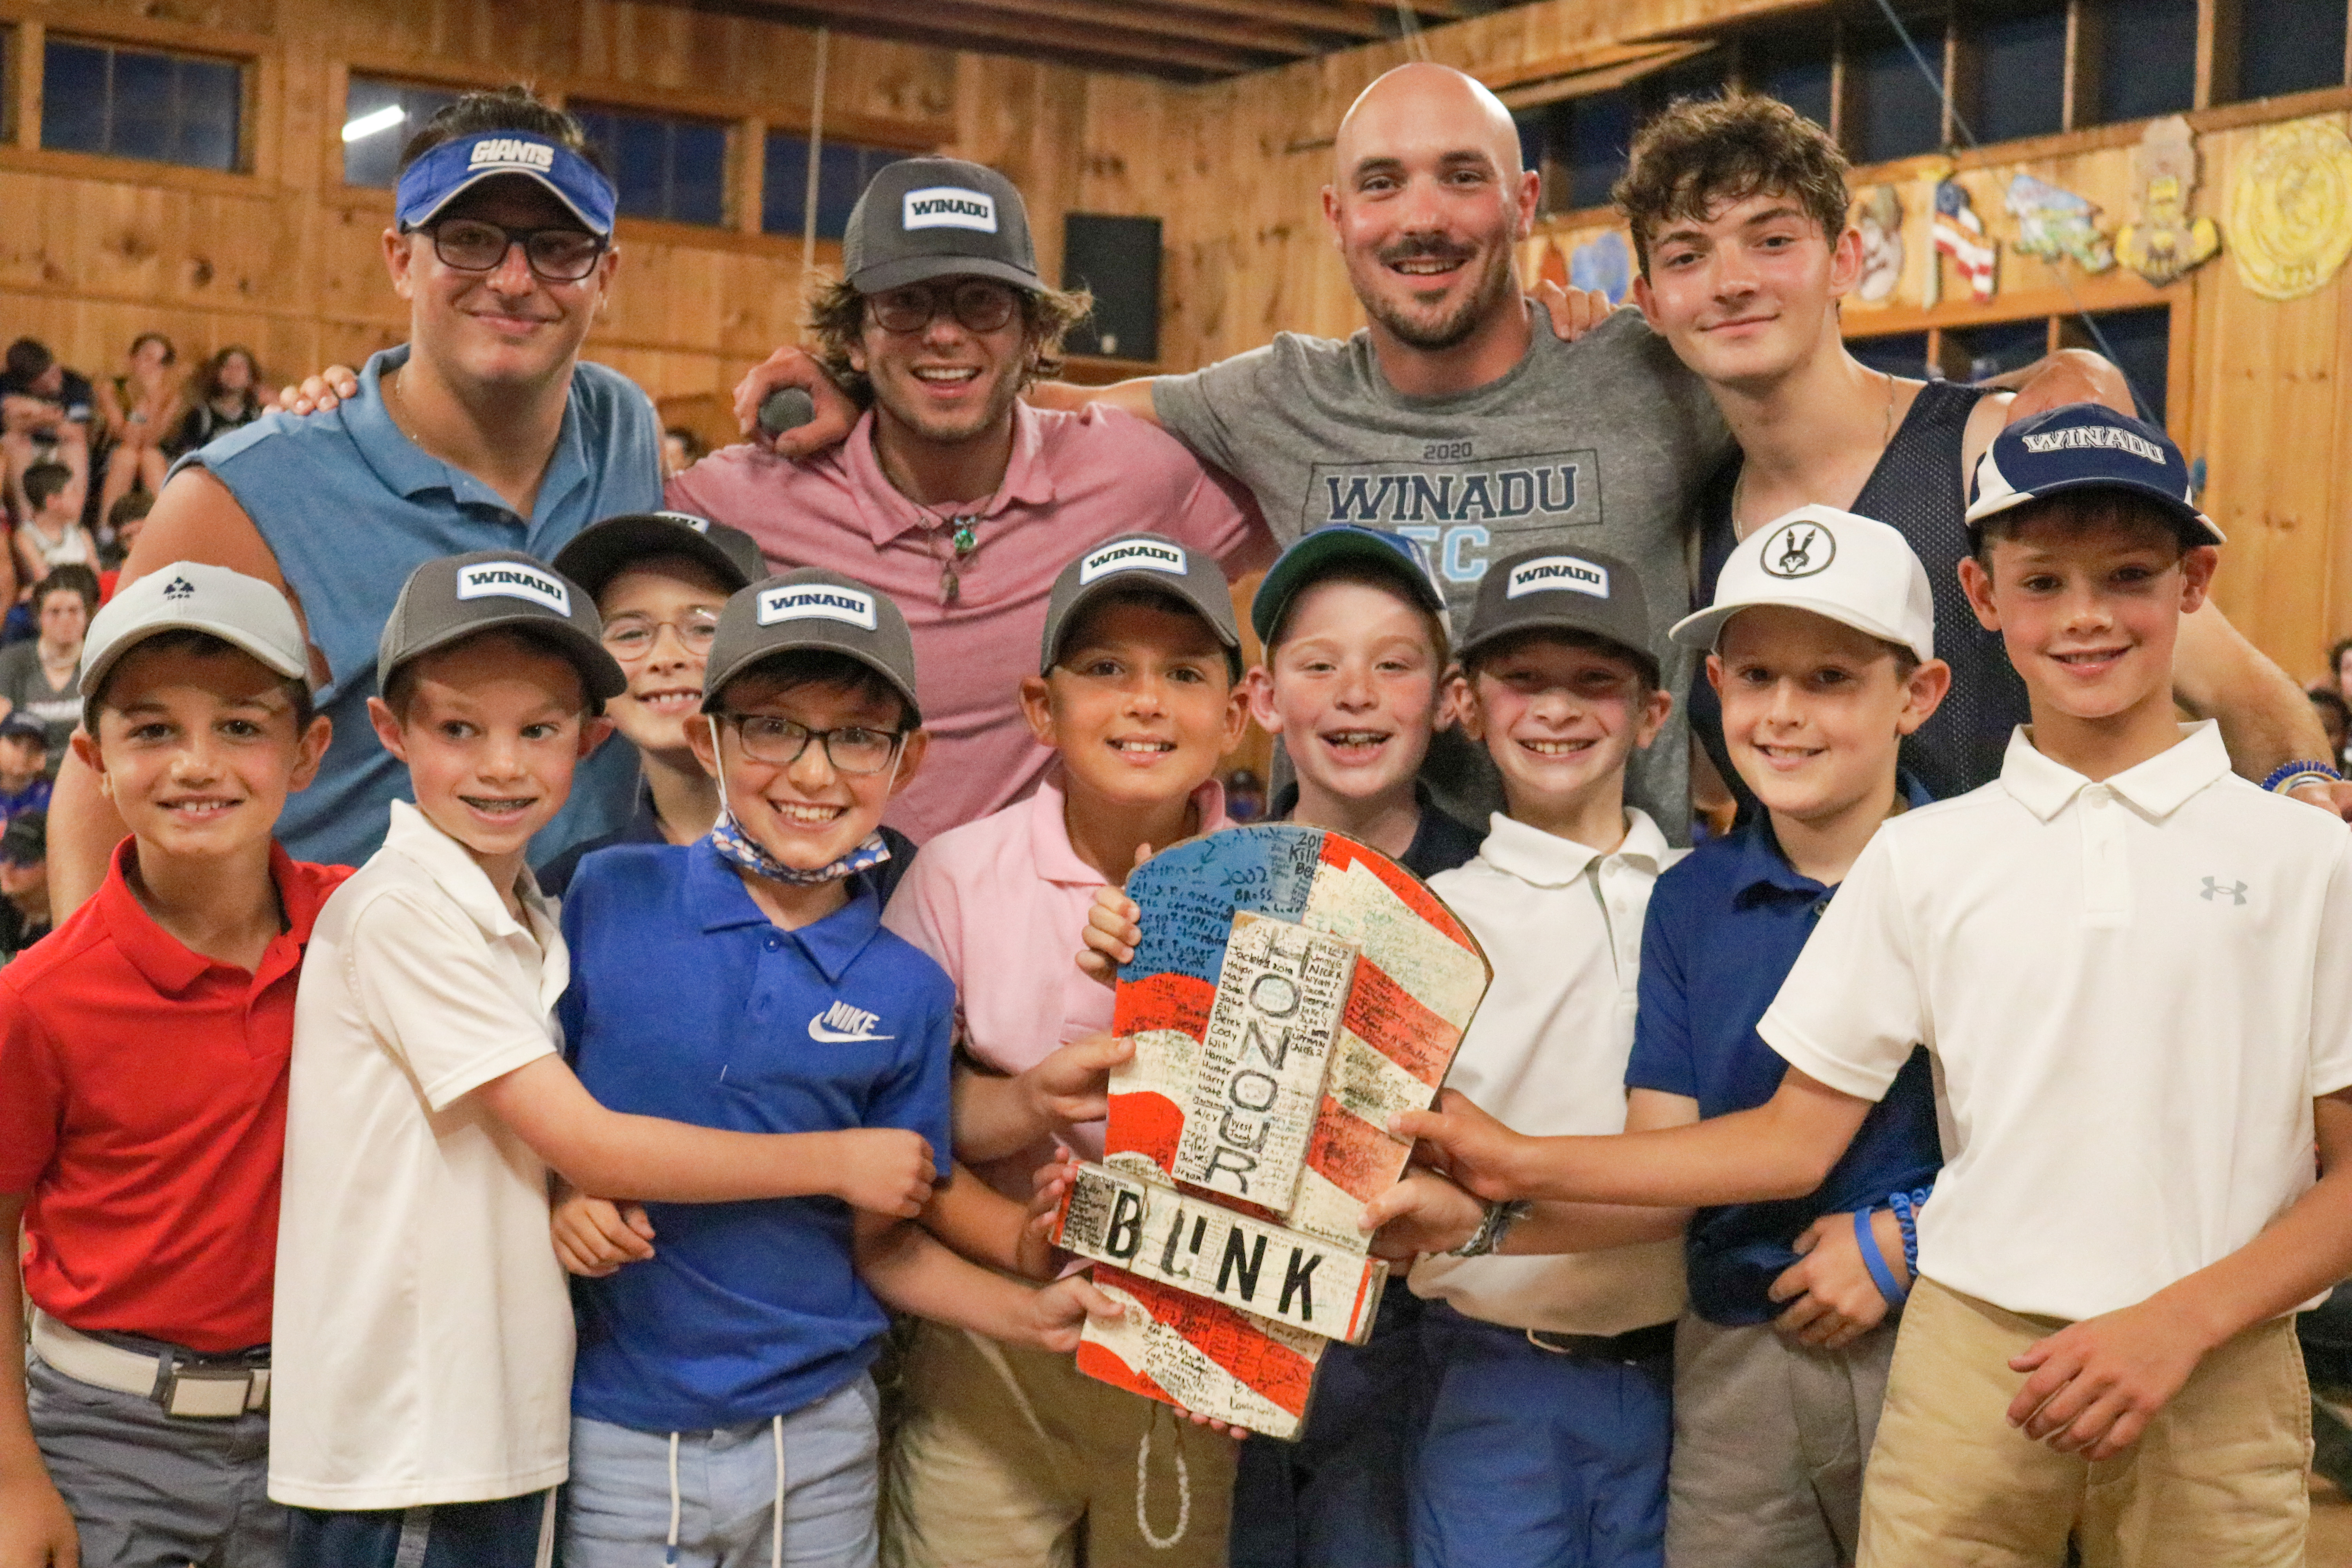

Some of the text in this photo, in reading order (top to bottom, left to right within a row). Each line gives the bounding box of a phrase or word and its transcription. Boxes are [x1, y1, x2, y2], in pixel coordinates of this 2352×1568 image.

[471, 139, 555, 167] GIANTS
[912, 199, 988, 218] WINADU
[1424, 441, 1473, 459] 2020
[2022, 426, 2167, 465] WINADU
[1325, 464, 1579, 523] WINADU
[1088, 546, 1178, 568] WINADU
[1515, 565, 1600, 584] WINADU
[468, 571, 562, 600] WINADU
[769, 594, 865, 613] WINADU
[823, 1000, 881, 1035] NIKE
[1215, 1011, 1241, 1029] Derek
[1211, 1024, 1236, 1042] Cody
[1208, 1037, 1228, 1050] Will
[1198, 1070, 1225, 1087] Harry
[1232, 1118, 1252, 1133] West
